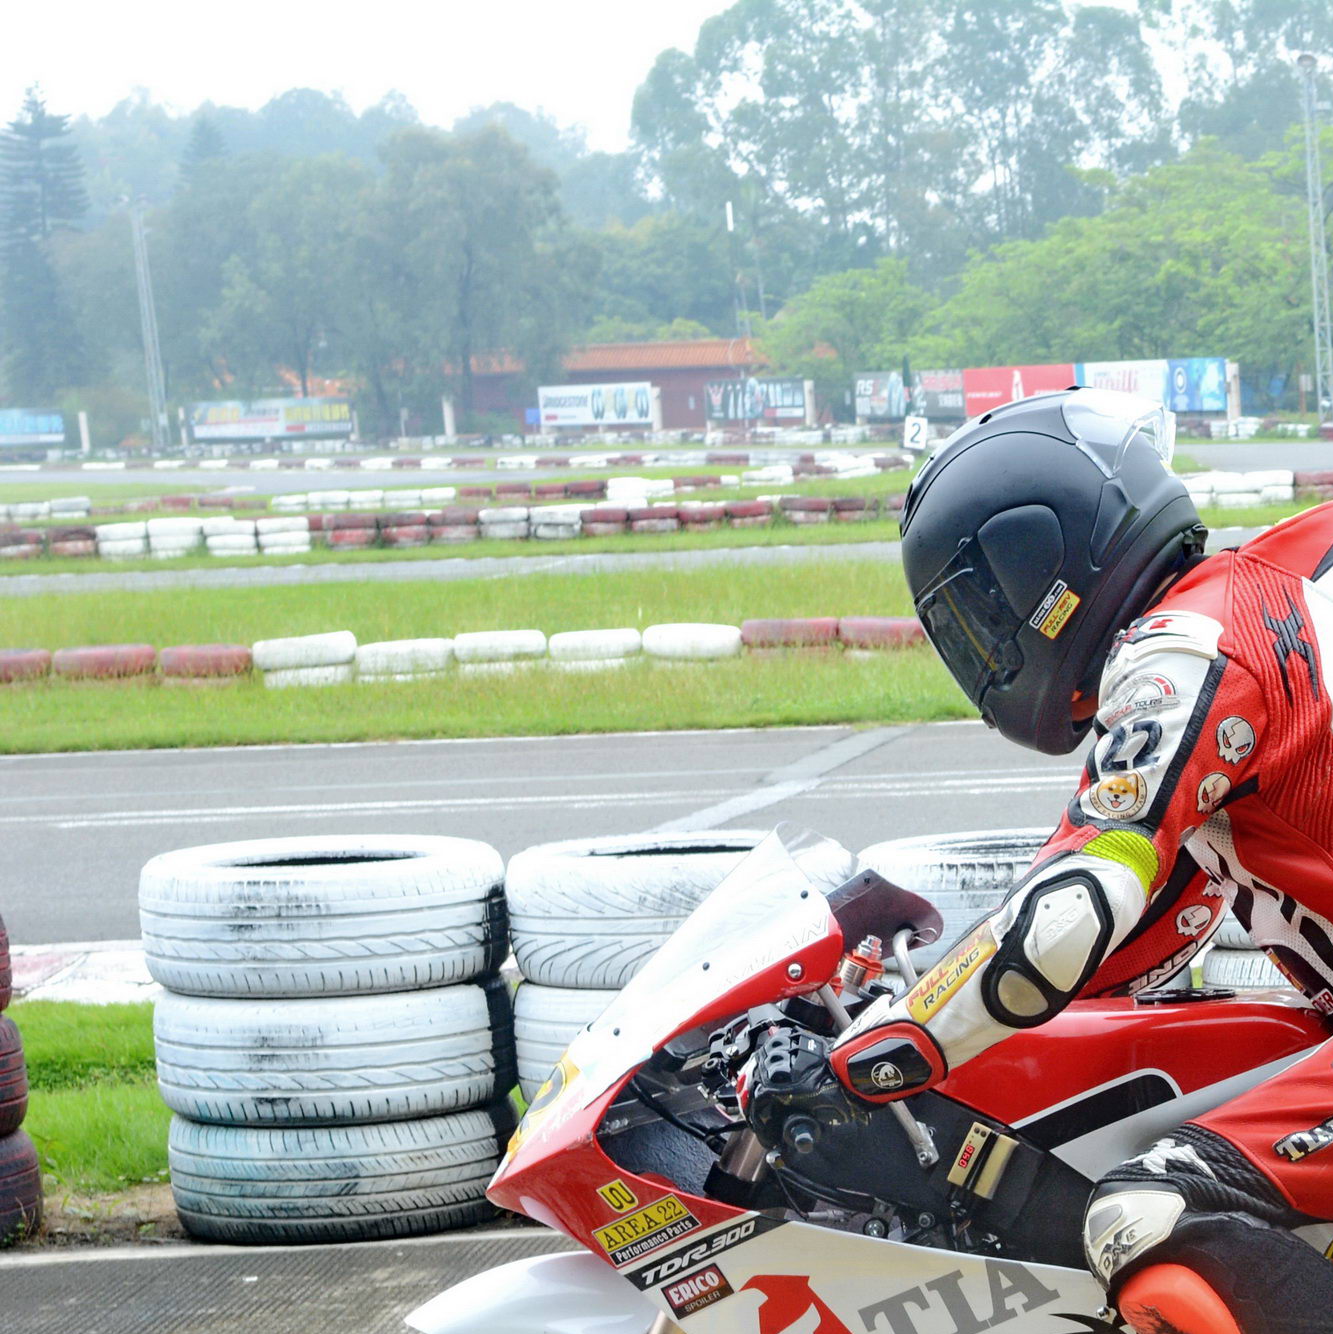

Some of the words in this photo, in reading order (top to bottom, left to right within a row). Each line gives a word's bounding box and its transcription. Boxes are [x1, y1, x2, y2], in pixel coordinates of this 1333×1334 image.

[910, 422, 922, 444] 2
[1101, 720, 1162, 772] 22
[924, 947, 981, 1010] RACING
[603, 1211, 662, 1249] AREA
[656, 1200, 683, 1222] 22
[615, 1231, 669, 1263] Performance
[668, 1219, 693, 1237] Parts
[669, 1271, 720, 1305] ERICO
[684, 1290, 721, 1313] SPOILER
